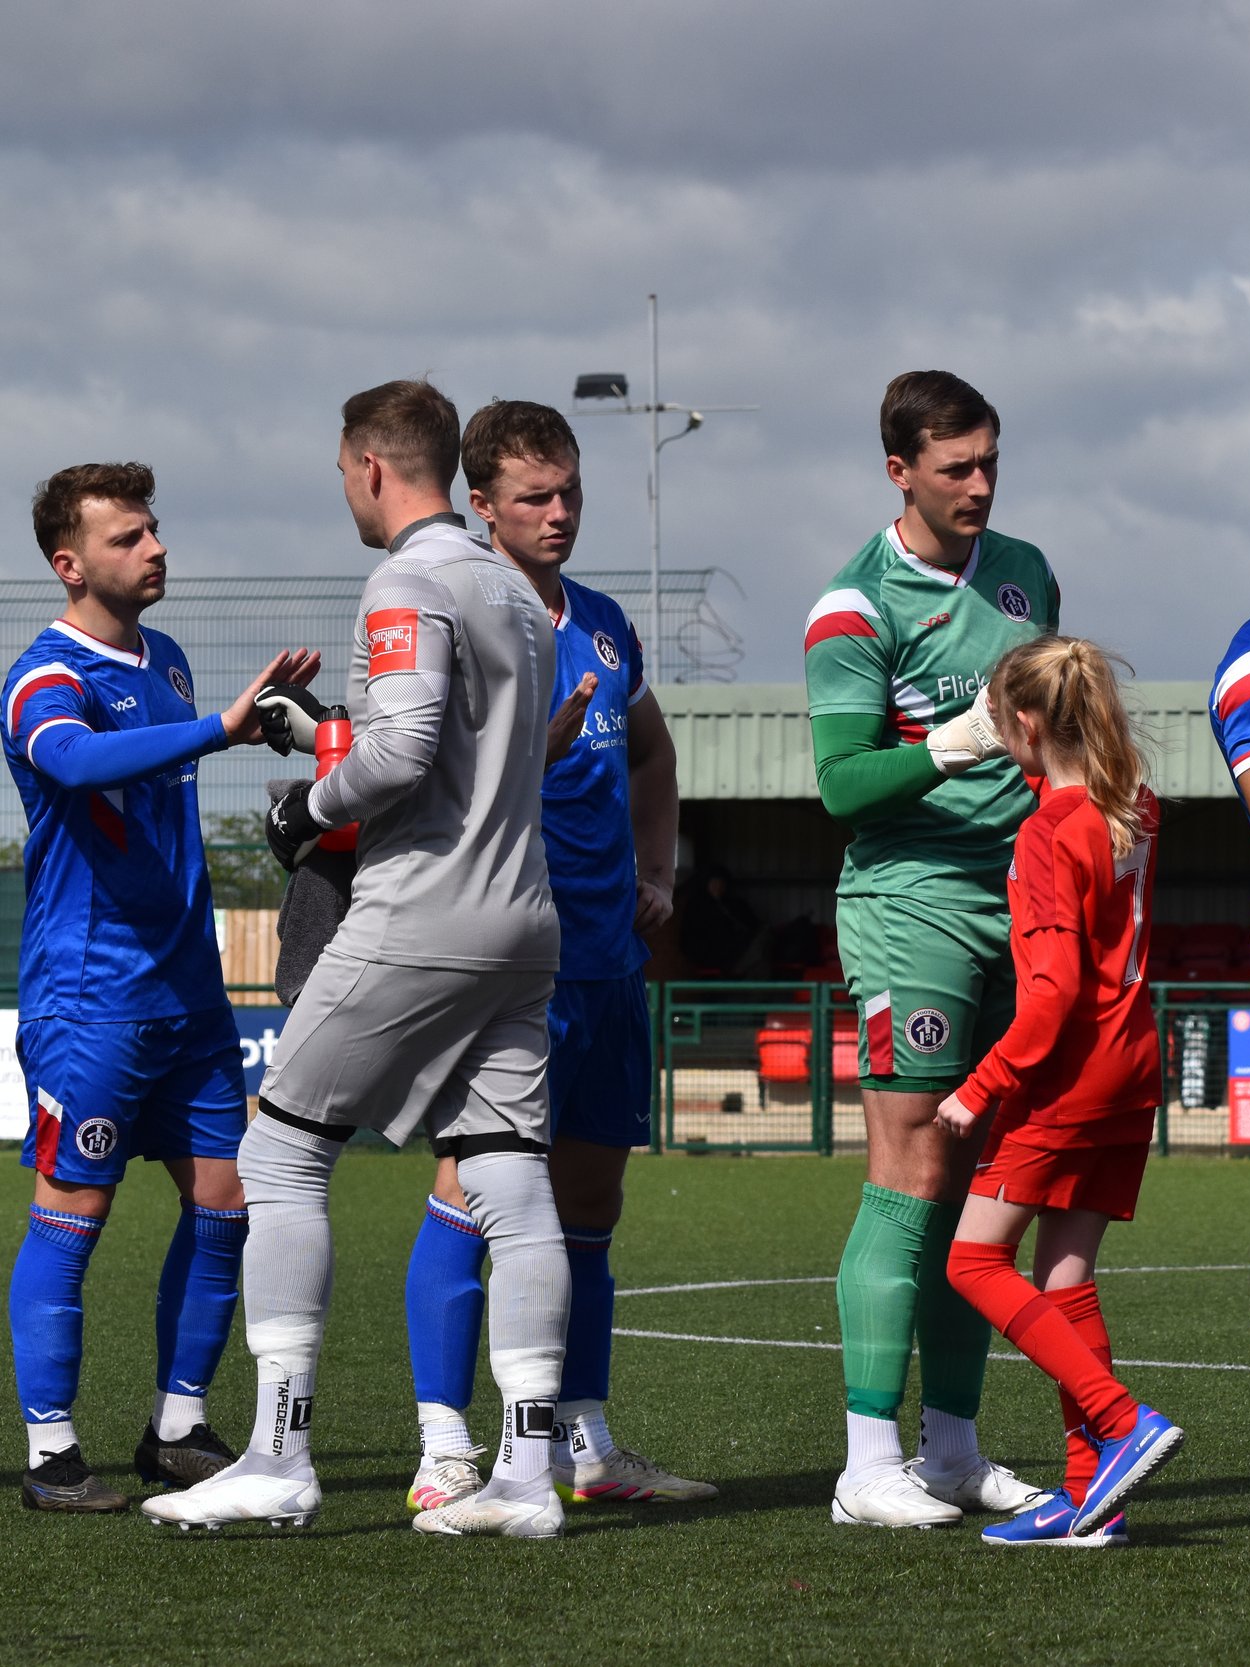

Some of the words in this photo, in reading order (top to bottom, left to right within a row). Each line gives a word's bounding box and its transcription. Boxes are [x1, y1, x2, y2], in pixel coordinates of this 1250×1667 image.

[372, 629, 404, 644] PITCHING
[385, 640, 392, 651] IN
[937, 669, 986, 701] Flick
[110, 696, 137, 712] VX3
[595, 711, 610, 733] &
[1114, 838, 1151, 987] 7
[916, 1010, 942, 1019] FOOTBALL
[272, 1378, 290, 1457] TAPEDESIGN
